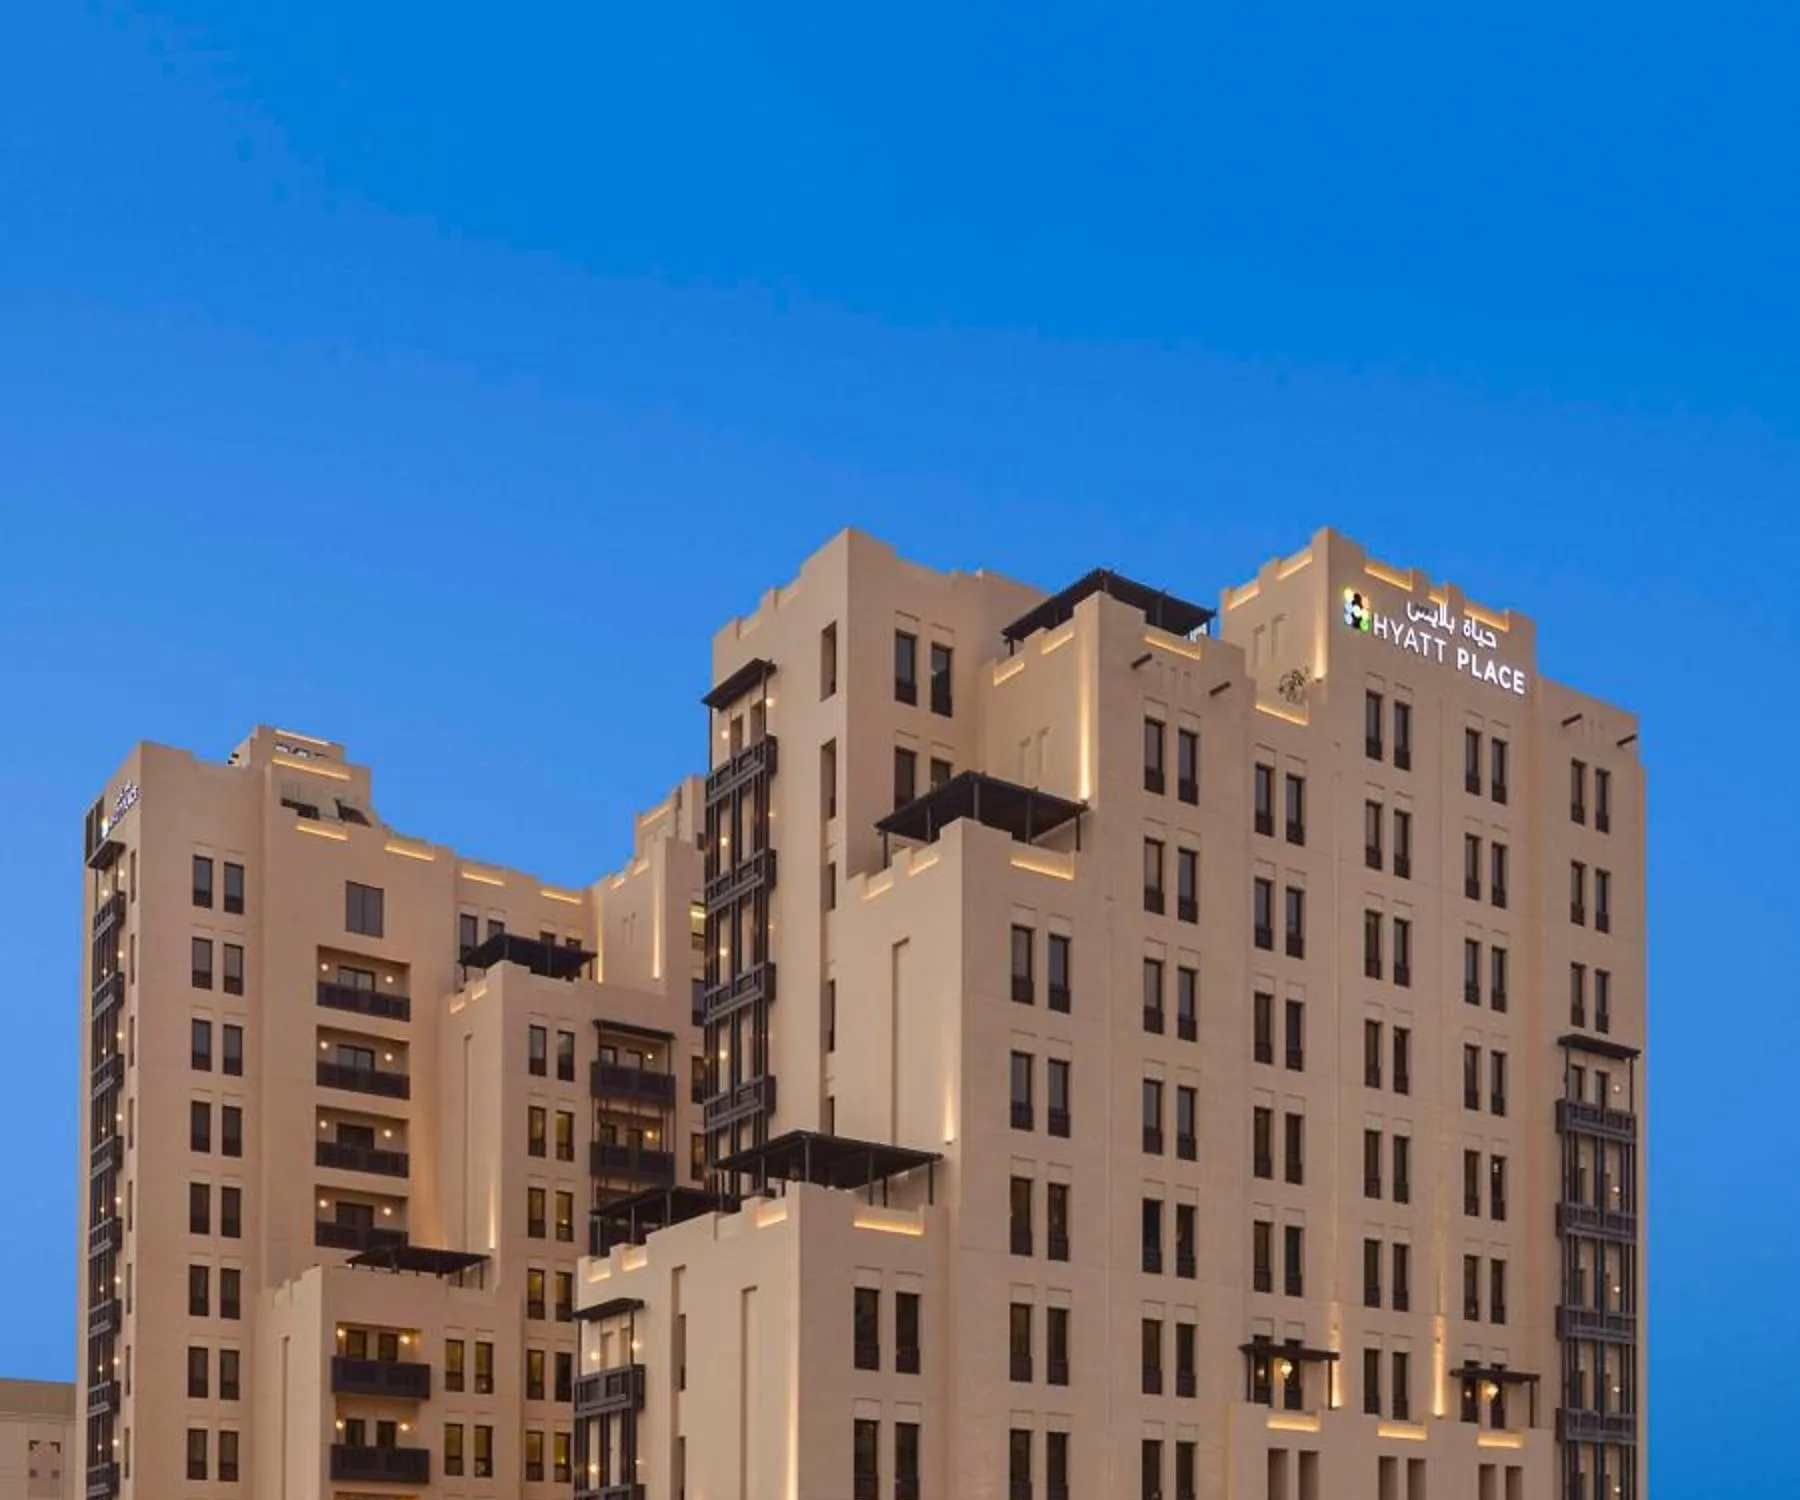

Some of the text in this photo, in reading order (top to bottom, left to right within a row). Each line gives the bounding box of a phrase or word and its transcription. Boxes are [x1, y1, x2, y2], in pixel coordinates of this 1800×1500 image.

[1373, 613, 1526, 695] HYATT PLACE
[1463, 616, 1498, 648] حياة
